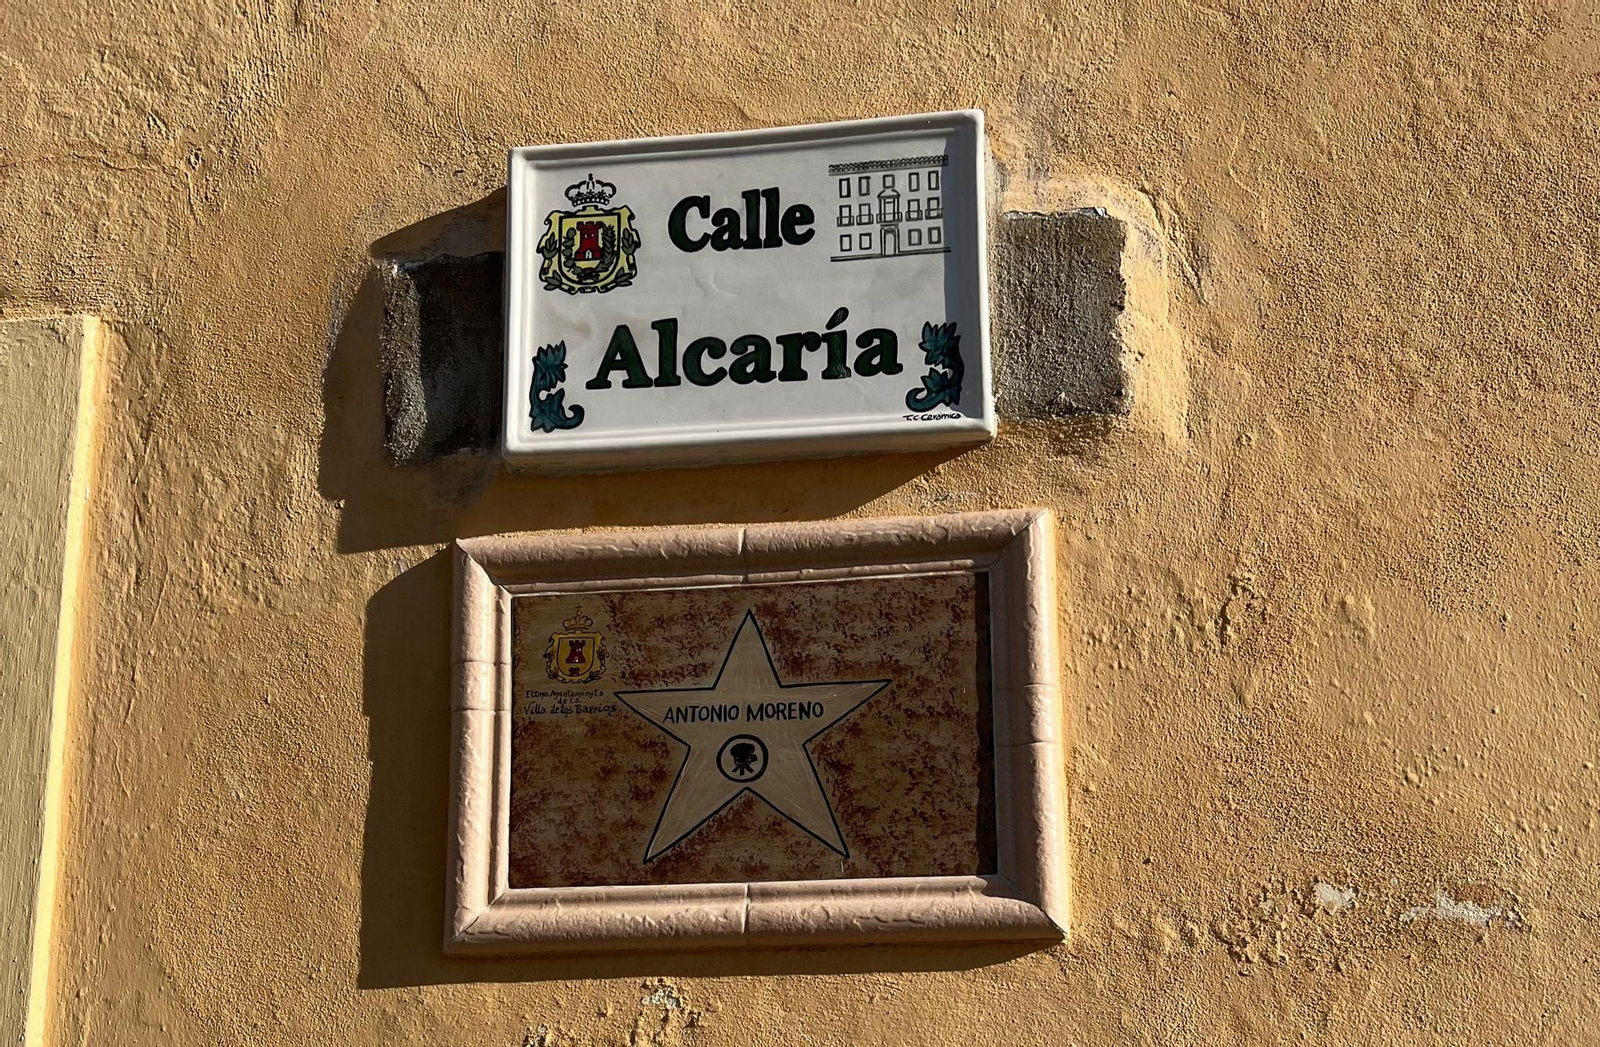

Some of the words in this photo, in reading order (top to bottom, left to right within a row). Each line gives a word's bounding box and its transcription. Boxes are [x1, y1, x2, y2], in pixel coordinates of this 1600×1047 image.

[668, 187, 815, 252] Calle
[585, 306, 903, 390] Alcaría
[524, 701, 546, 715] Villa
[575, 703, 617, 716] Barrios
[662, 704, 740, 723] ANTONIO
[746, 700, 824, 722] MORENO
